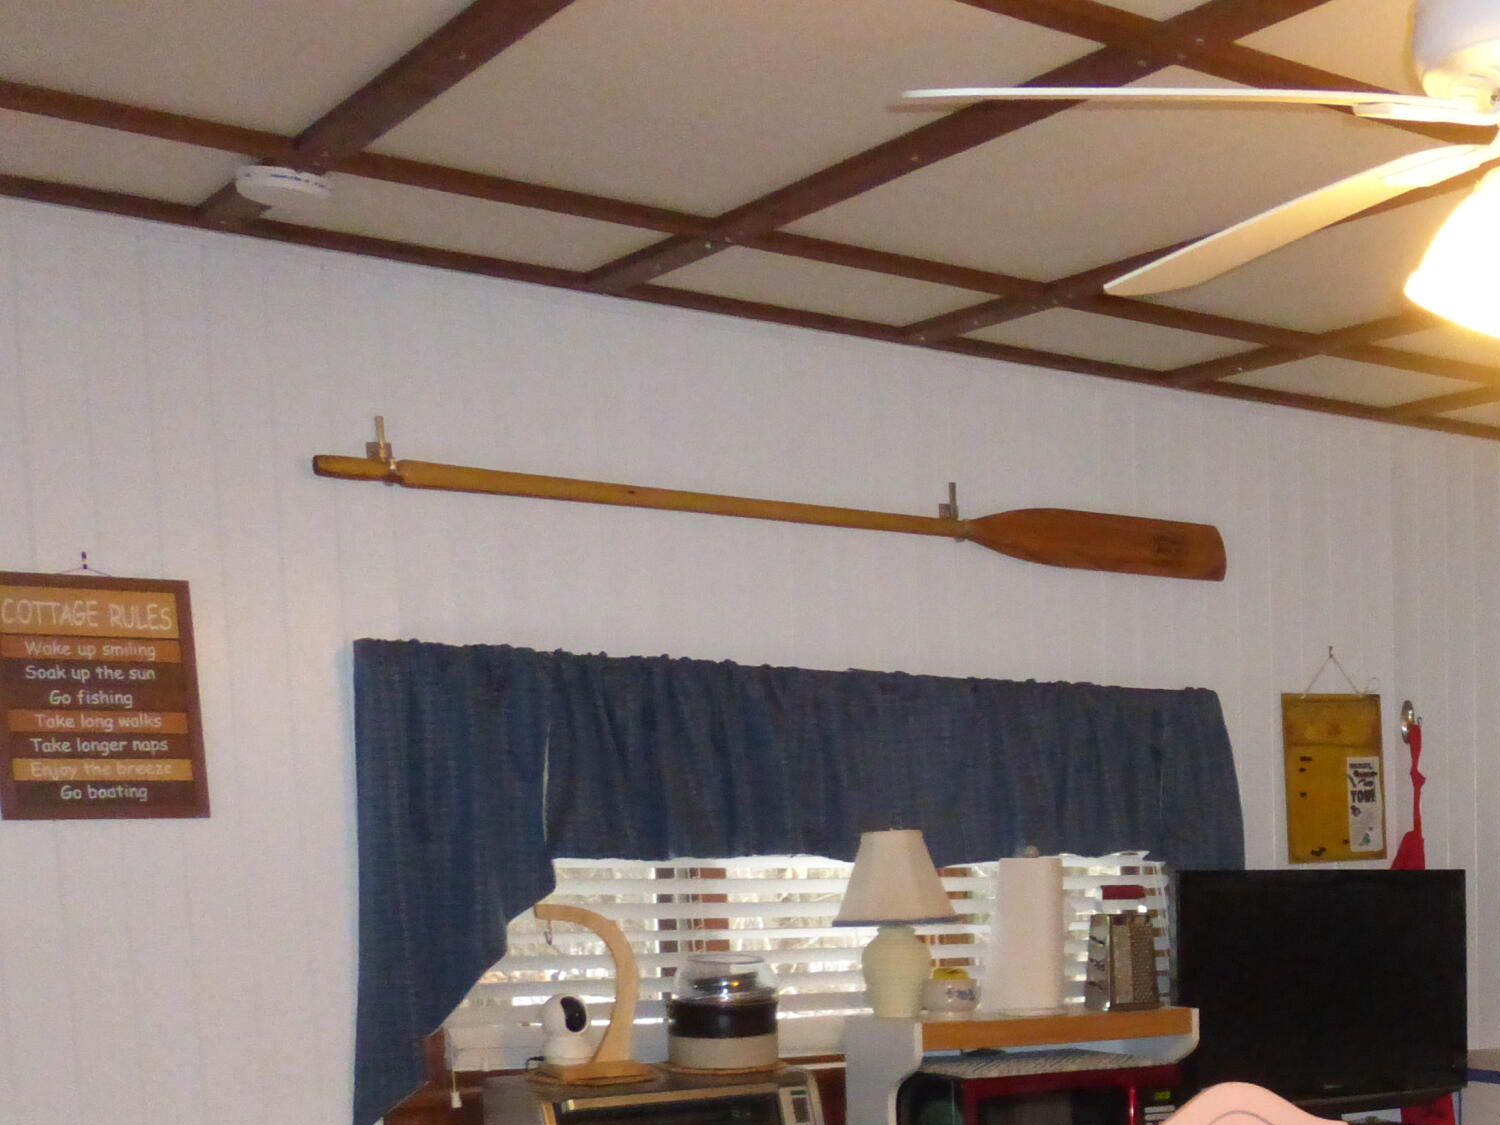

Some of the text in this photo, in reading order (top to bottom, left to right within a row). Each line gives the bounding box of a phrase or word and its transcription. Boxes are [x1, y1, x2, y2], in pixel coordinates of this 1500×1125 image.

[1, 599, 173, 631] COTTAGE RULES
[25, 641, 156, 660] Wake up smiling
[25, 666, 156, 682] Soak up the sun
[49, 690, 133, 708] Go fishing
[34, 714, 162, 730] Take long walks
[30, 738, 168, 755] Take longer naps
[30, 761, 173, 780] Enjoy the breeze
[60, 785, 148, 801] Go boating
